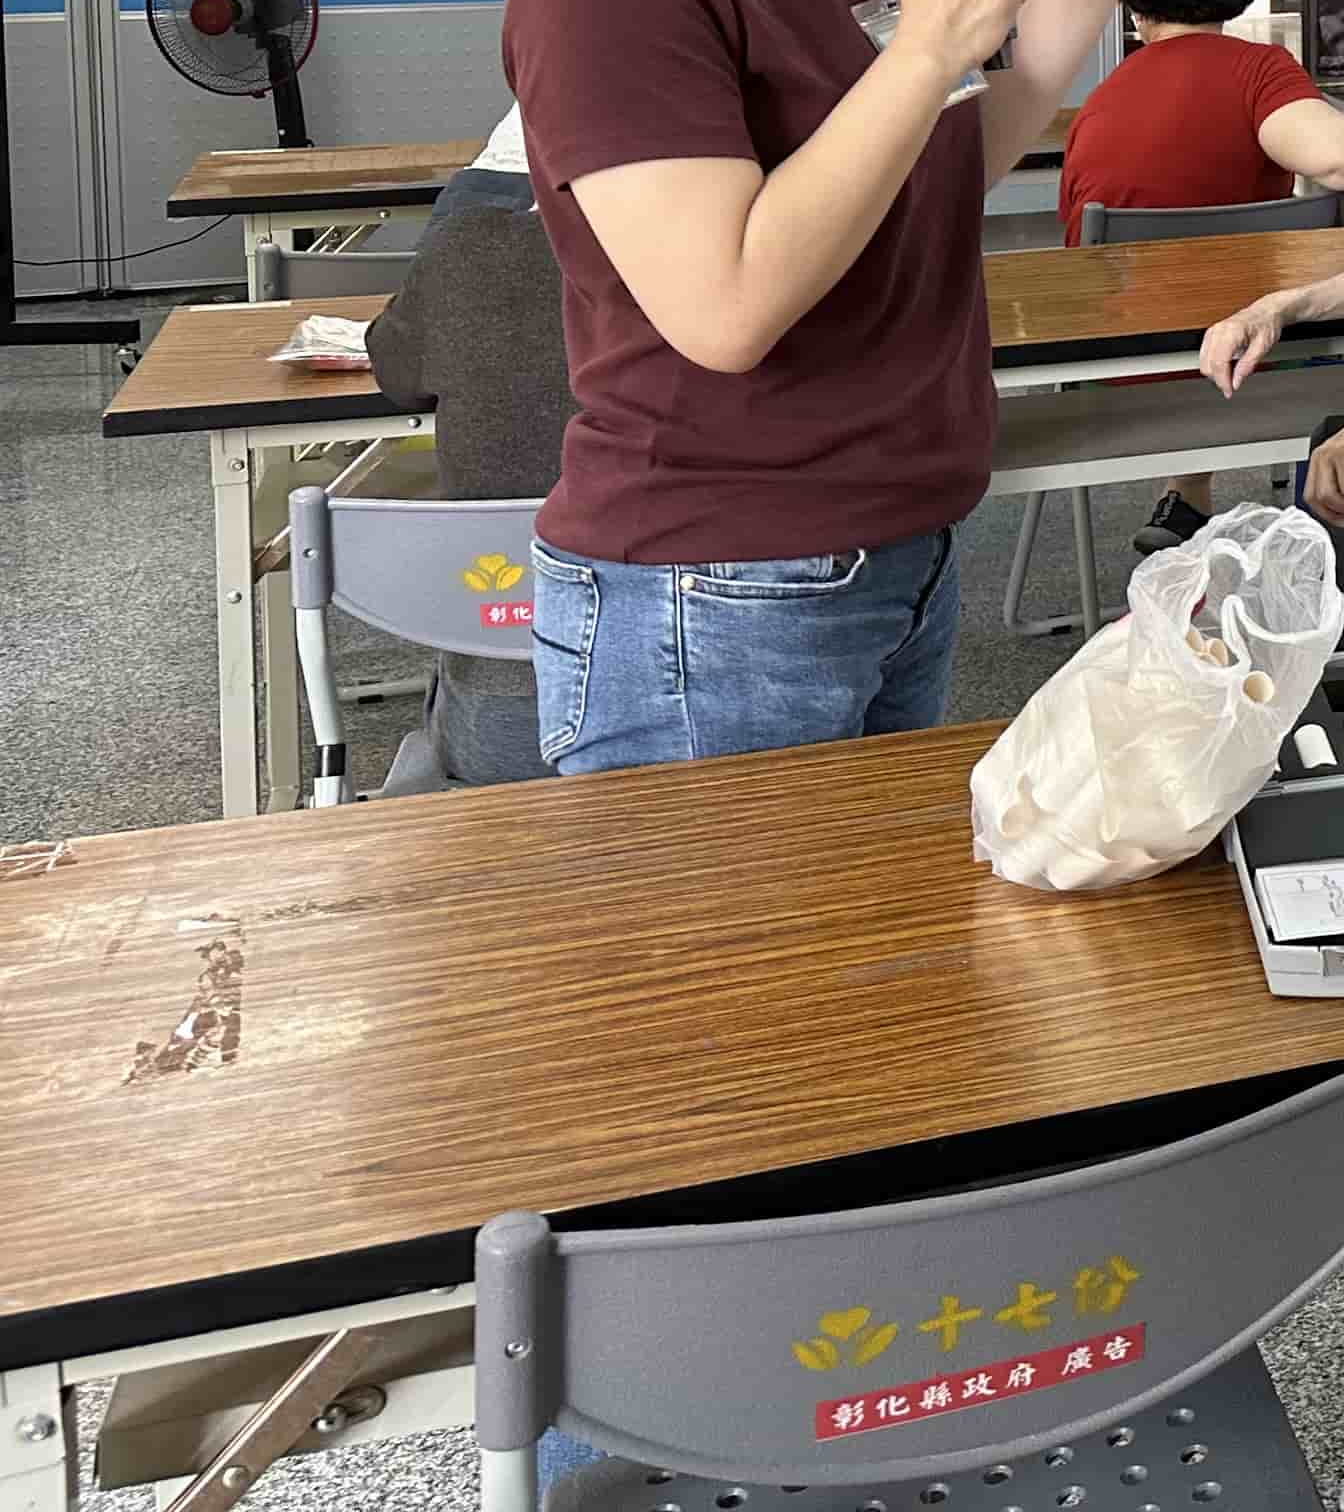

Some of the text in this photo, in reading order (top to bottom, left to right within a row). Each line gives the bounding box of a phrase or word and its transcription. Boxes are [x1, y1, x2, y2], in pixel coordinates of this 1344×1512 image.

[831, 1336, 1134, 1430] 彰化縣政府 廣告
